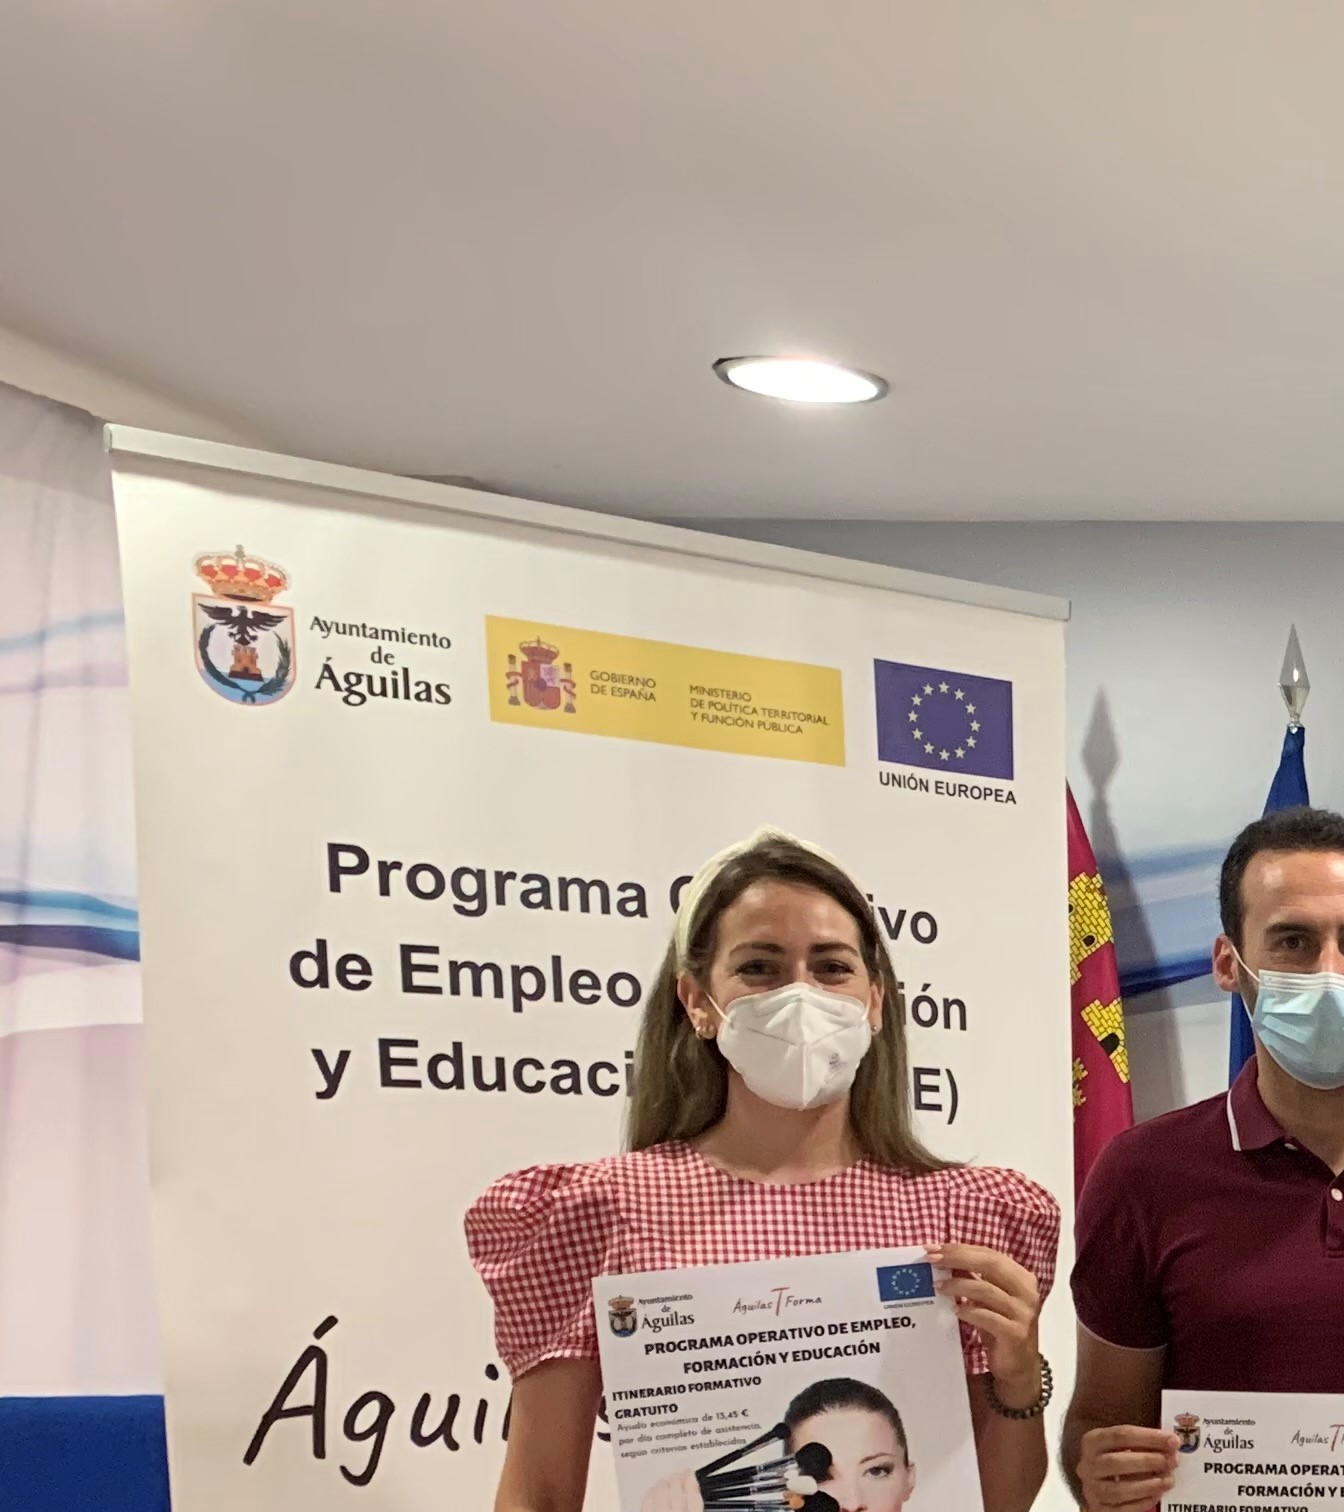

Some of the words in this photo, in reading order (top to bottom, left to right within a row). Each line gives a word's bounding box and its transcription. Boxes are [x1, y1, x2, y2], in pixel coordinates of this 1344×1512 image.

[309, 615, 451, 649] Ayuntamiento
[371, 647, 395, 665] de
[315, 655, 451, 706] Águilas
[590, 670, 656, 689] GOBIERNO
[591, 684, 608, 696] DE
[611, 686, 656, 702] ESPAÑA
[690, 685, 752, 702] MINISTERIO
[690, 698, 705, 709] DE
[708, 699, 758, 716] POLÍTICA
[761, 706, 829, 726] TERRITORIAL
[691, 711, 699, 721] Y
[701, 712, 754, 730] FUNCIÓN
[879, 771, 929, 793] UNIÓN
[935, 781, 1017, 804] EUROPEA
[327, 842, 648, 918] Programa
[289, 938, 373, 991] de
[399, 943, 642, 1013] Empleo
[311, 1046, 352, 1099] y
[378, 1037, 635, 1097] Educaci
[641, 1311, 694, 1333] Águilas
[644, 1335, 734, 1354] PROGRAMA
[735, 1325, 825, 1344] OPERATIVO
[827, 1322, 849, 1335] DE
[683, 1351, 776, 1373] FORMACIÓN
[778, 1351, 789, 1363] Y
[791, 1339, 880, 1361] EDUCACIÓN
[243, 1315, 509, 1487] Águi
[1203, 1435, 1254, 1453] Águilas
[1203, 1462, 1288, 1475] PROGRAMA
[1237, 1482, 1325, 1497] FORMACIÓN
[1327, 1486, 1338, 1497] Y
